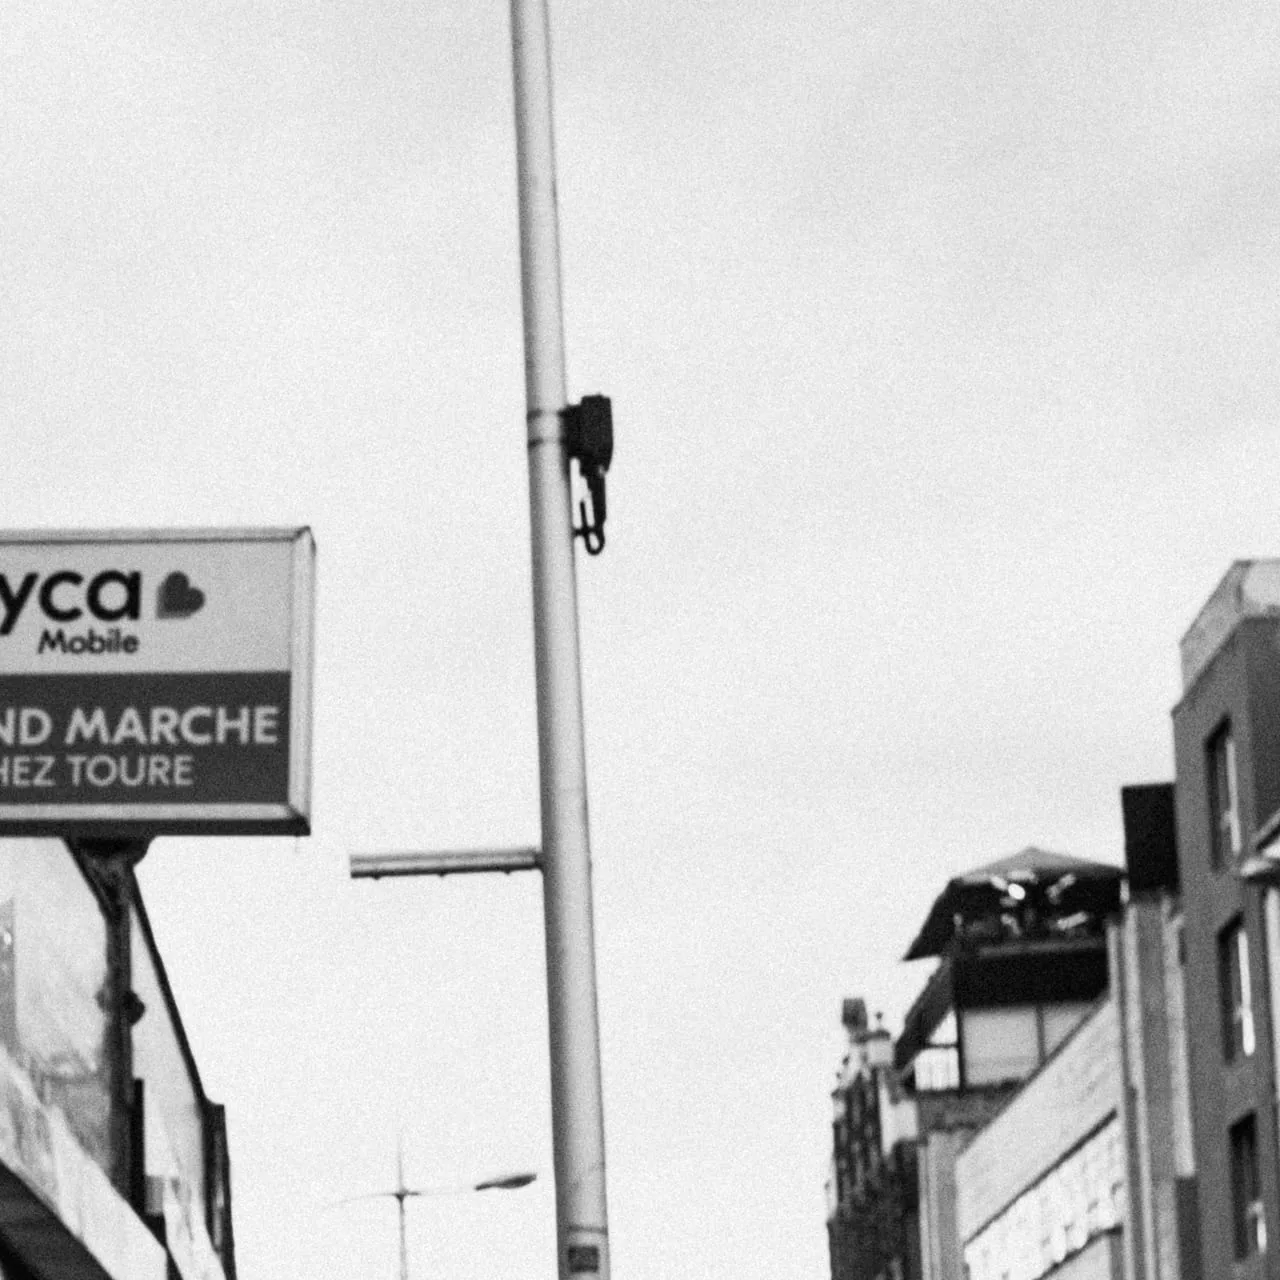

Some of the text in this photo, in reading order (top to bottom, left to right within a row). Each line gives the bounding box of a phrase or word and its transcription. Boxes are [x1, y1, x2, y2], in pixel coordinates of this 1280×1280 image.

[37, 628, 141, 655] Mobile
[64, 705, 280, 745] MARCHE
[66, 754, 195, 787] TOURE
